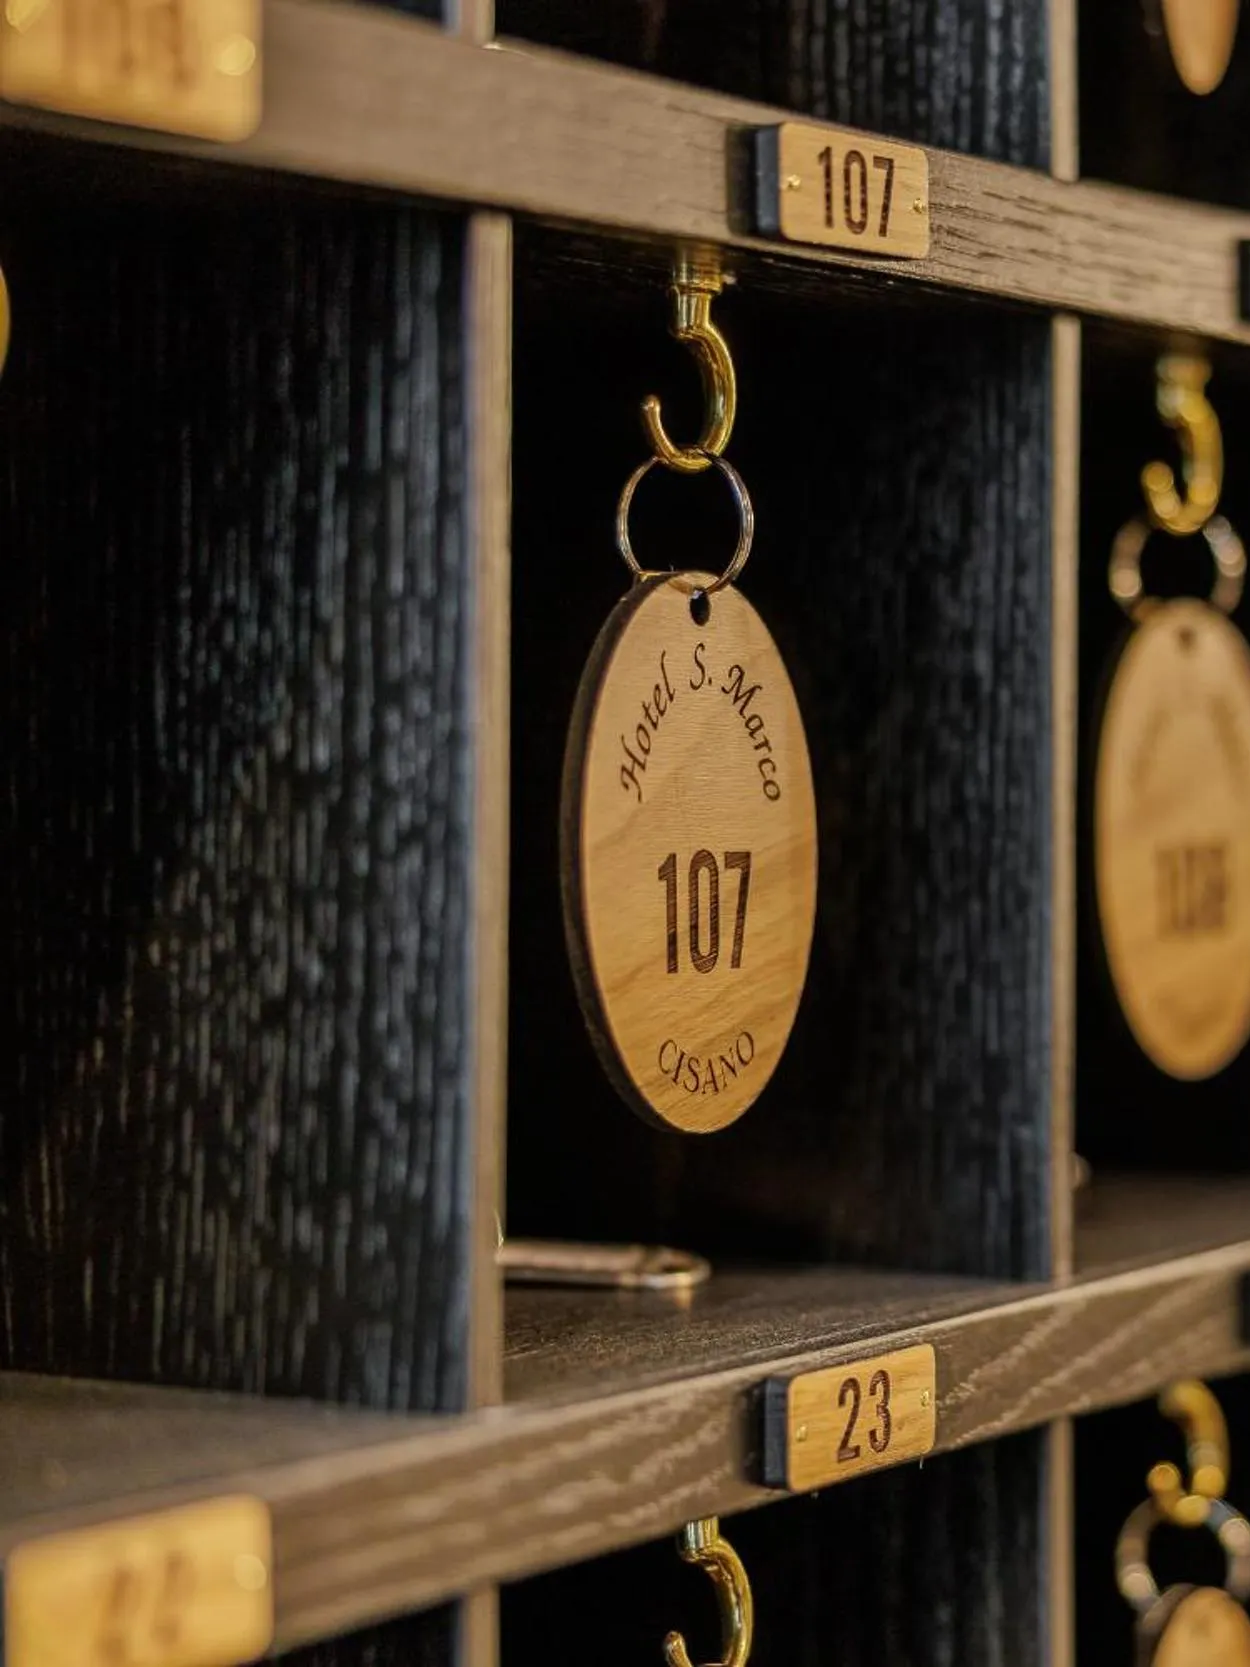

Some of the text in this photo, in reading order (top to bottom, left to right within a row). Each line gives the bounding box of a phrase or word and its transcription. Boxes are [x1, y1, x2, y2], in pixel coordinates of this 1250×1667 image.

[816, 145, 895, 238] 107
[619, 642, 781, 803] Hotel S. Marco
[657, 848, 752, 975] 107
[657, 1030, 756, 1096] CISANO
[836, 1368, 892, 1464] 23
